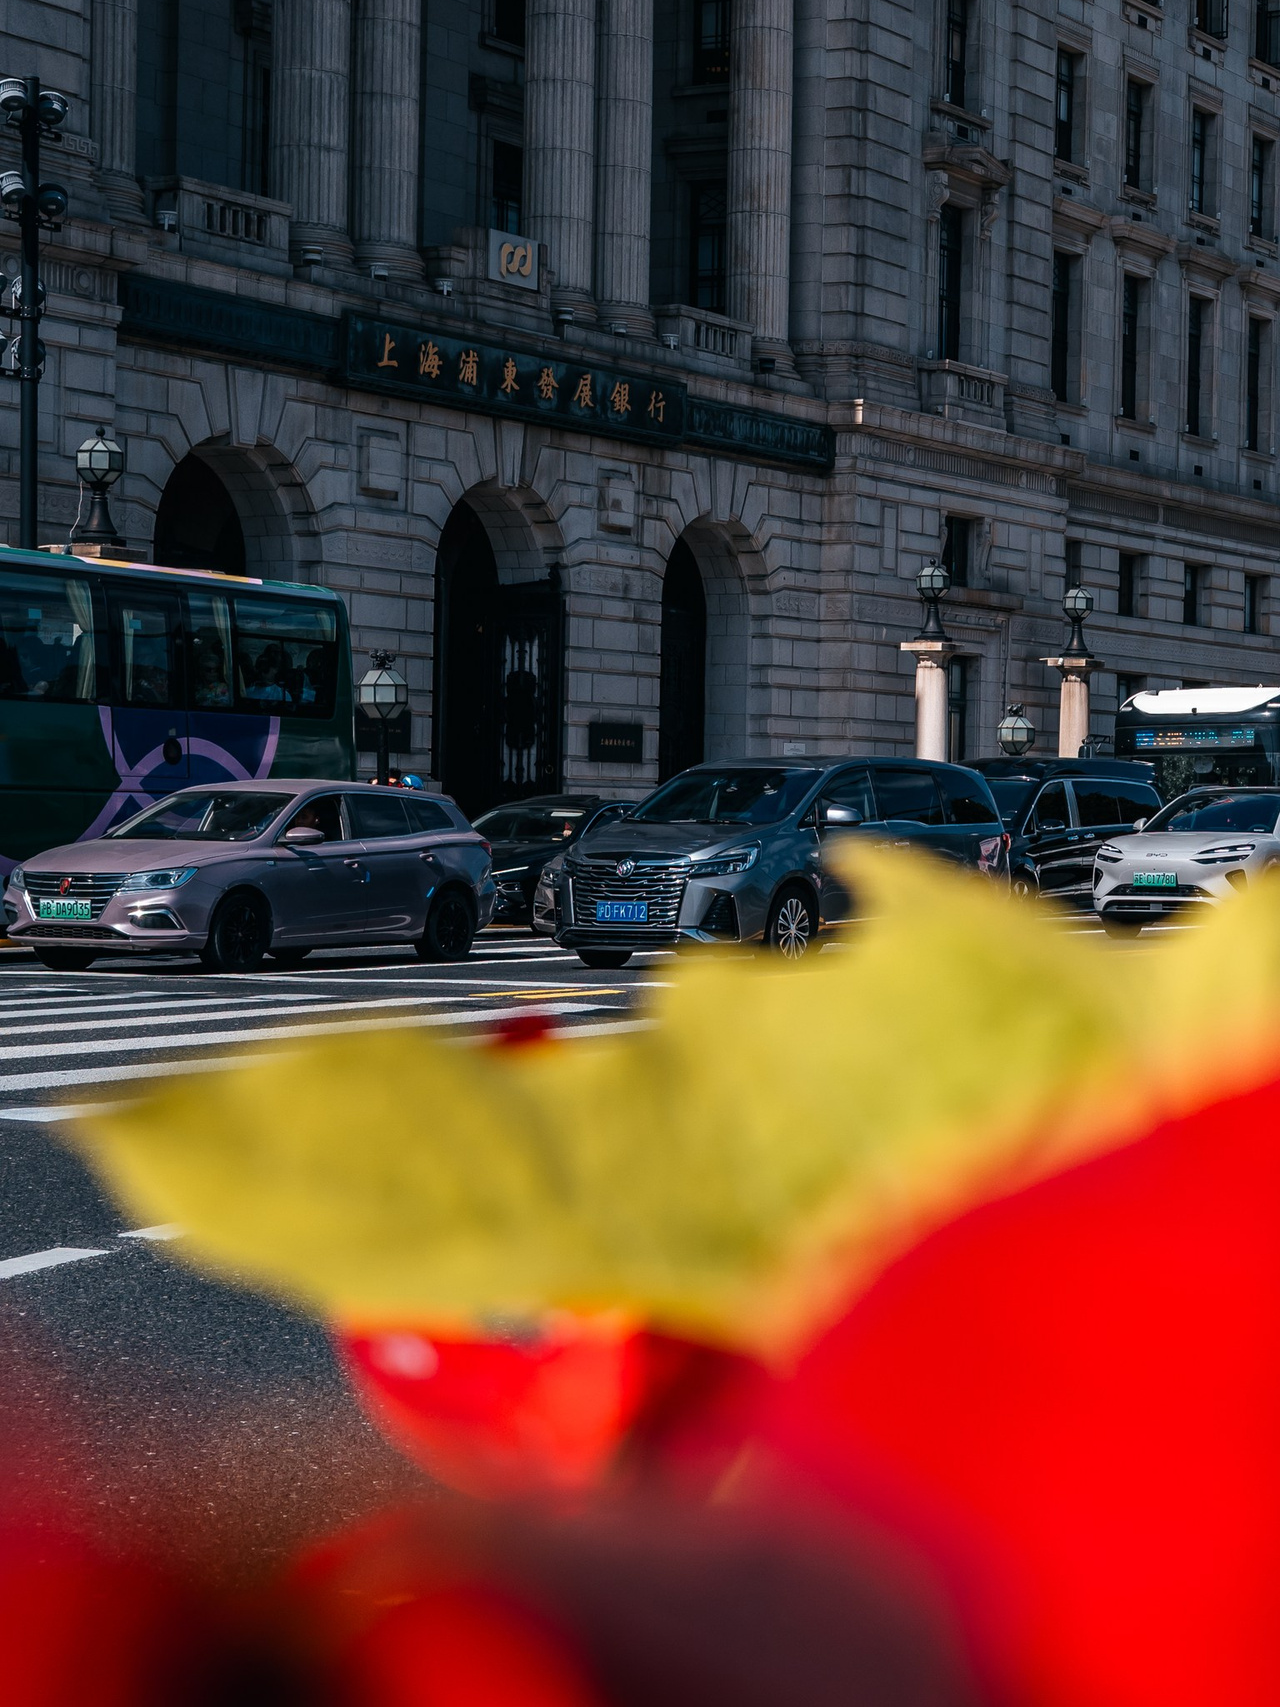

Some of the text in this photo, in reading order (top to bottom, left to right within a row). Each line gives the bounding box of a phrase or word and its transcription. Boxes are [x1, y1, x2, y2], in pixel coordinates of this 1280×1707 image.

[377, 332, 666, 423] 上海浦東發展銀行
